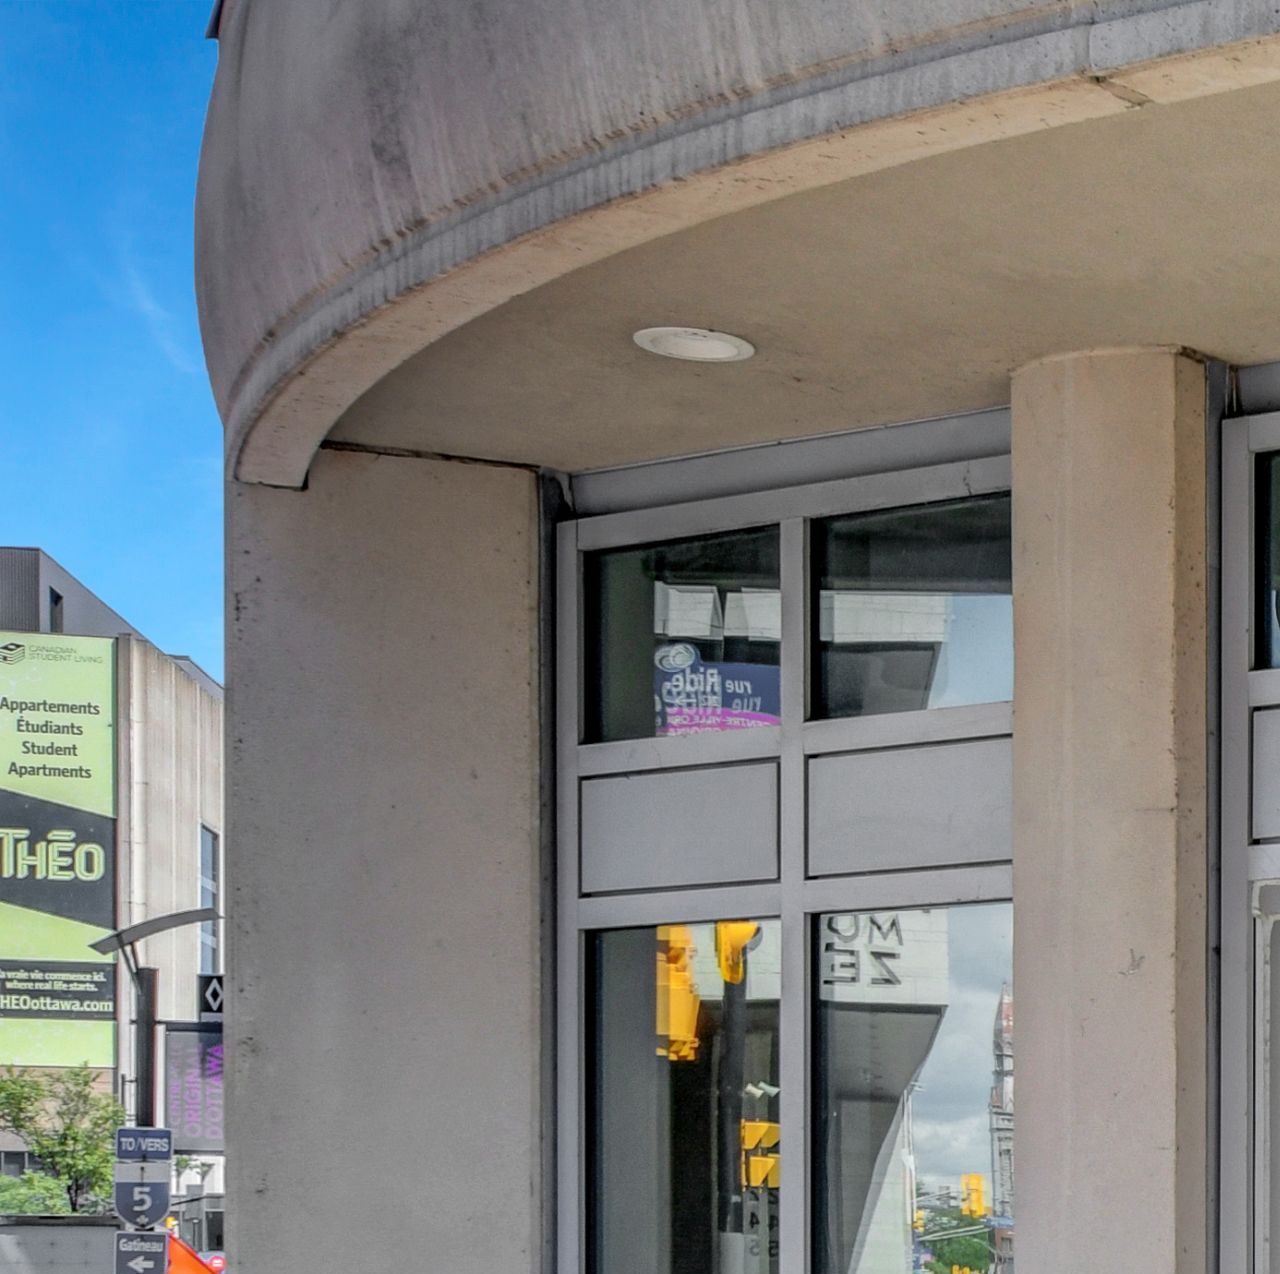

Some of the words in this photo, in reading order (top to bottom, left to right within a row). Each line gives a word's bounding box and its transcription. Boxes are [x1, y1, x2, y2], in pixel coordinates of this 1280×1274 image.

[0, 696, 100, 715] Appartements
[16, 715, 83, 736] Étudiants
[21, 740, 78, 757] Student
[8, 761, 92, 779] Apartments
[132, 1186, 153, 1212] 5
[119, 1238, 163, 1253] Gatineau
